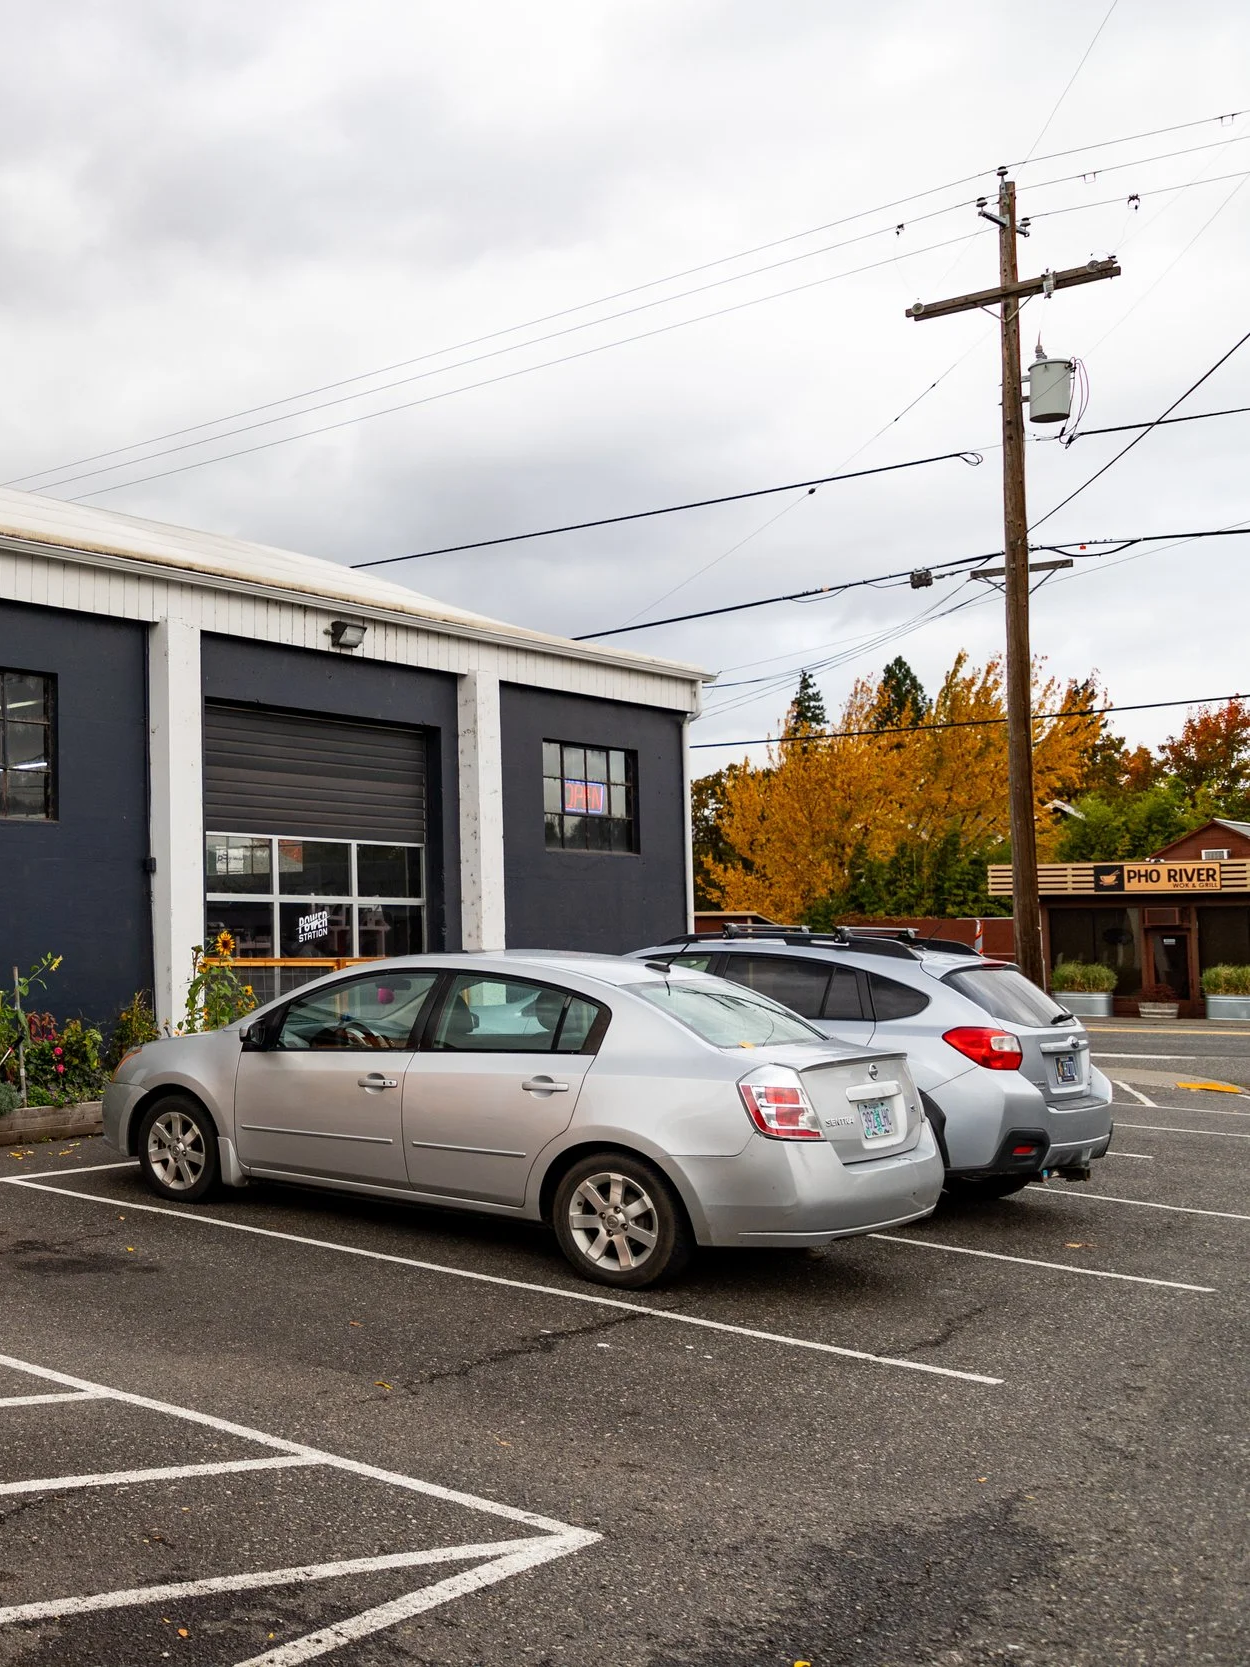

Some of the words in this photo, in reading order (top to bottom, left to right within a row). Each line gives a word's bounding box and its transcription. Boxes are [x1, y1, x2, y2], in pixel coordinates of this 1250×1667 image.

[1127, 869, 1161, 883] PHO
[1167, 868, 1217, 882] RIVER
[297, 910, 329, 934] POWER
[298, 927, 328, 943] STATION
[825, 1117, 854, 1128] SENTRA
